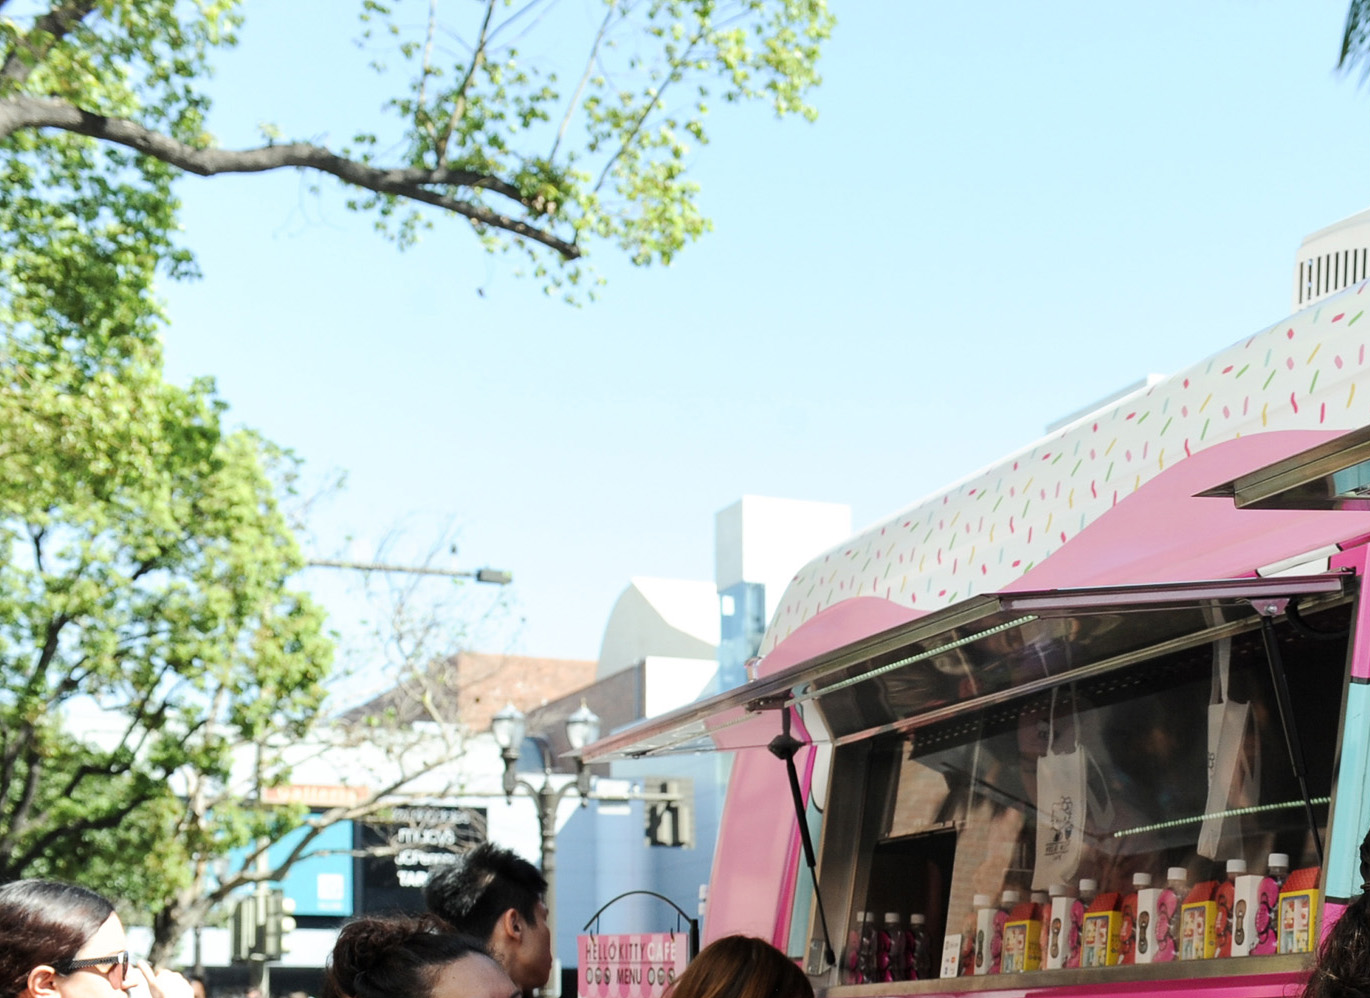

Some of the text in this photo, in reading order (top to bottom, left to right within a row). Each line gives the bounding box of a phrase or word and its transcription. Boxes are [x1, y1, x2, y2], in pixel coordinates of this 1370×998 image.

[586, 941, 617, 960] HELLO
[619, 943, 646, 960] KITTY
[617, 969, 642, 985] MENU
